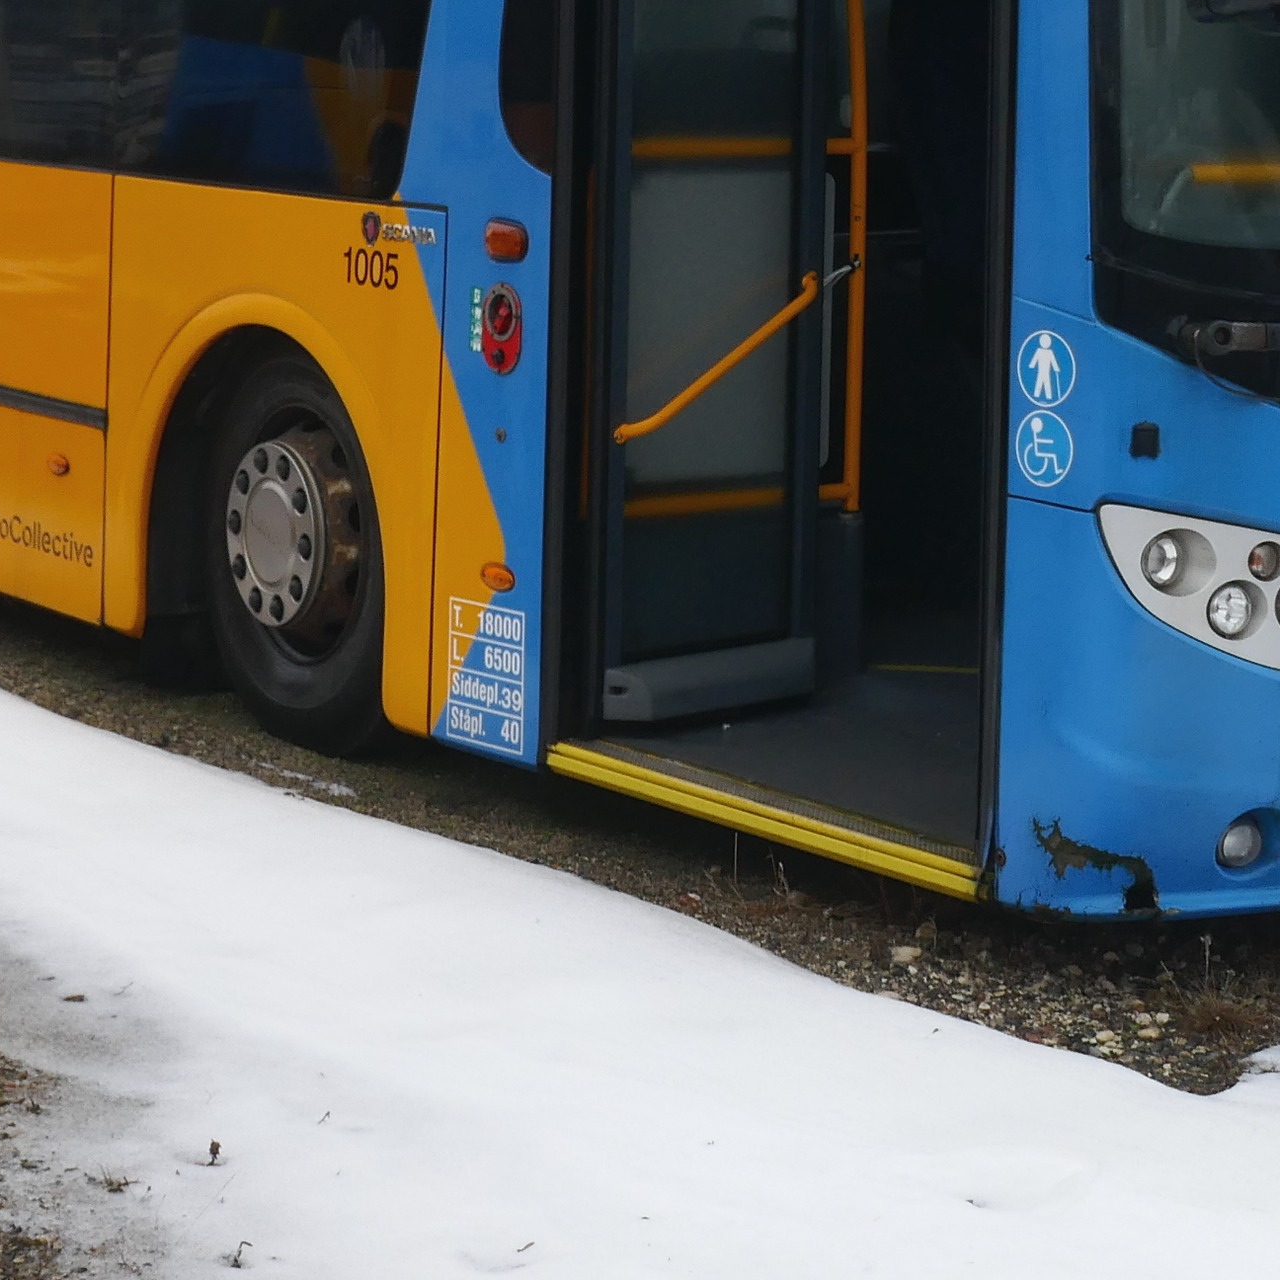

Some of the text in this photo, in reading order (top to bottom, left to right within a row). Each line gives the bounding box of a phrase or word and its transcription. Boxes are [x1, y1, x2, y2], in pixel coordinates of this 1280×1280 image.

[382, 223, 437, 245] SCANIA
[344, 246, 399, 291] 1005
[477, 611, 521, 642] 18000
[484, 646, 521, 675] 6500
[450, 706, 520, 745] Ståpl. 40
